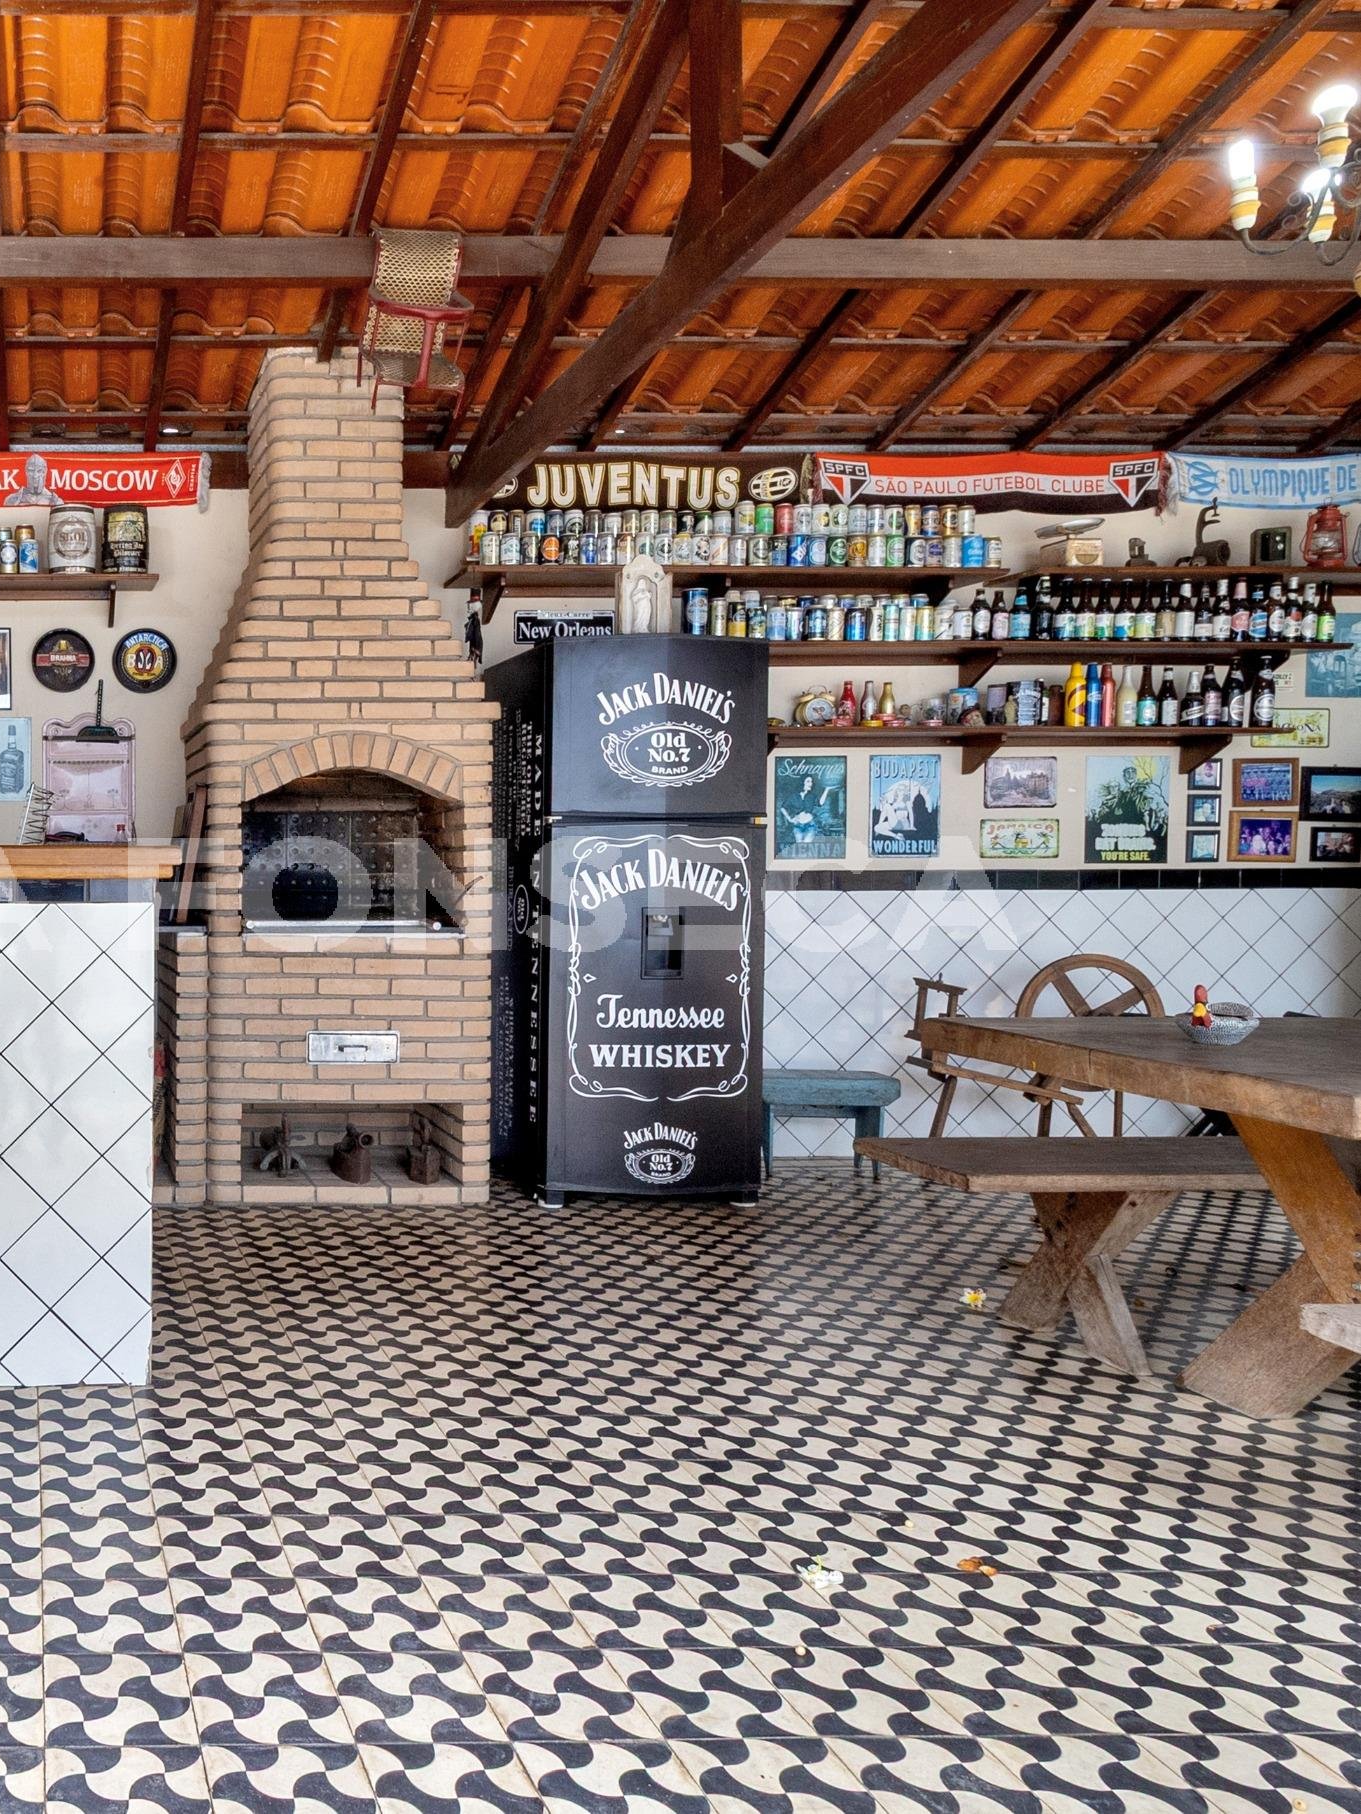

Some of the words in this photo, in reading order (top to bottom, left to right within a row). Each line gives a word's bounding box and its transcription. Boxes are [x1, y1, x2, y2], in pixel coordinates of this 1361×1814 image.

[824, 462, 866, 476] SPFC
[1112, 461, 1156, 475] SPFC
[49, 468, 159, 492] MOSCOW
[527, 460, 741, 510] JUVENTUS
[875, 475, 908, 495] SÃO
[914, 480, 968, 495] PAULO
[973, 476, 1044, 494] FUTEBOL
[1051, 478, 1105, 494] CLUBE
[1229, 466, 1330, 502] OLYMPIQUE
[1336, 464, 1357, 492] DE
[518, 621, 552, 640] New
[554, 621, 612, 637] Orleans
[123, 632, 170, 651] ANTARCTICA
[50, 654, 78, 662] BRAHMA
[596, 681, 653, 726] JACK
[653, 672, 737, 725] DANIEL'S
[650, 732, 687, 748] Old
[648, 747, 692, 764] No.7
[651, 765, 689, 775] BRAND
[872, 758, 938, 779] BUDAPEST
[533, 734, 543, 838] MADE
[986, 822, 1055, 835] JAMAICA
[780, 842, 842, 858] VIENNA
[872, 839, 938, 853] WONDERFUL
[1101, 851, 1129, 861] YOU'RE
[1129, 851, 1151, 861] SAFE.
[532, 852, 541, 891] IN
[579, 858, 647, 911] JACK
[646, 848, 746, 912] DANIEL'S
[528, 904, 540, 1123] TENNESSEE
[595, 993, 726, 1029] Tennessee
[588, 1044, 731, 1068] WHISKEY
[623, 1126, 654, 1149] JACK
[653, 1121, 699, 1150] DANIEL'S
[649, 1162, 674, 1171] No.7
[651, 1153, 671, 1163] Old
